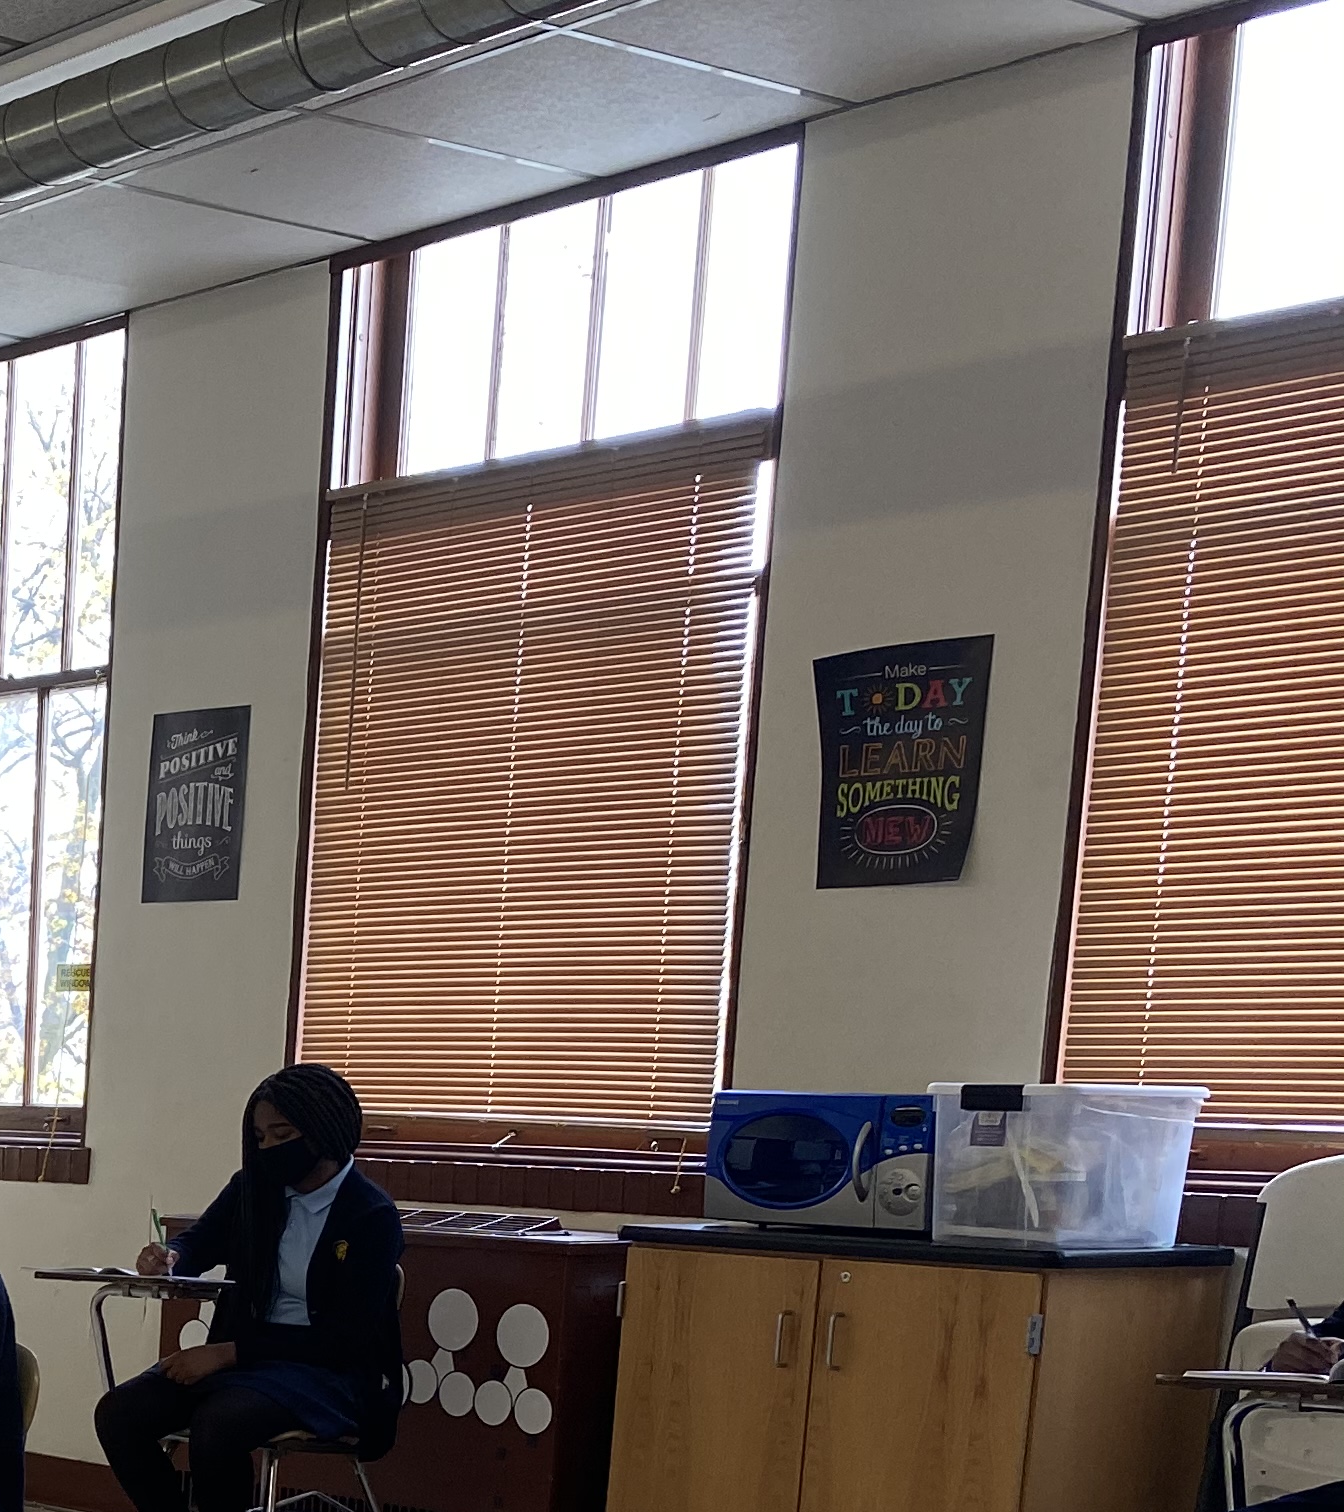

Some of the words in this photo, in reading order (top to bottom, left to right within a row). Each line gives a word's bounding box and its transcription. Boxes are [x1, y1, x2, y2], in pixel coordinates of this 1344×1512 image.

[885, 663, 927, 679] Make
[836, 677, 973, 717] TODAY
[167, 728, 200, 750] Think
[863, 717, 892, 736] the
[895, 714, 925, 740] day
[925, 711, 943, 731] to
[158, 737, 238, 779] POSITIVE
[214, 763, 232, 776] and
[838, 735, 967, 778] LEARN
[155, 782, 234, 836] POSITIVE
[836, 775, 961, 818] SOMETHING
[172, 831, 212, 856] things
[862, 815, 931, 847] NEW
[168, 860, 185, 876] WILL
[186, 857, 215, 876] HAPPEN
